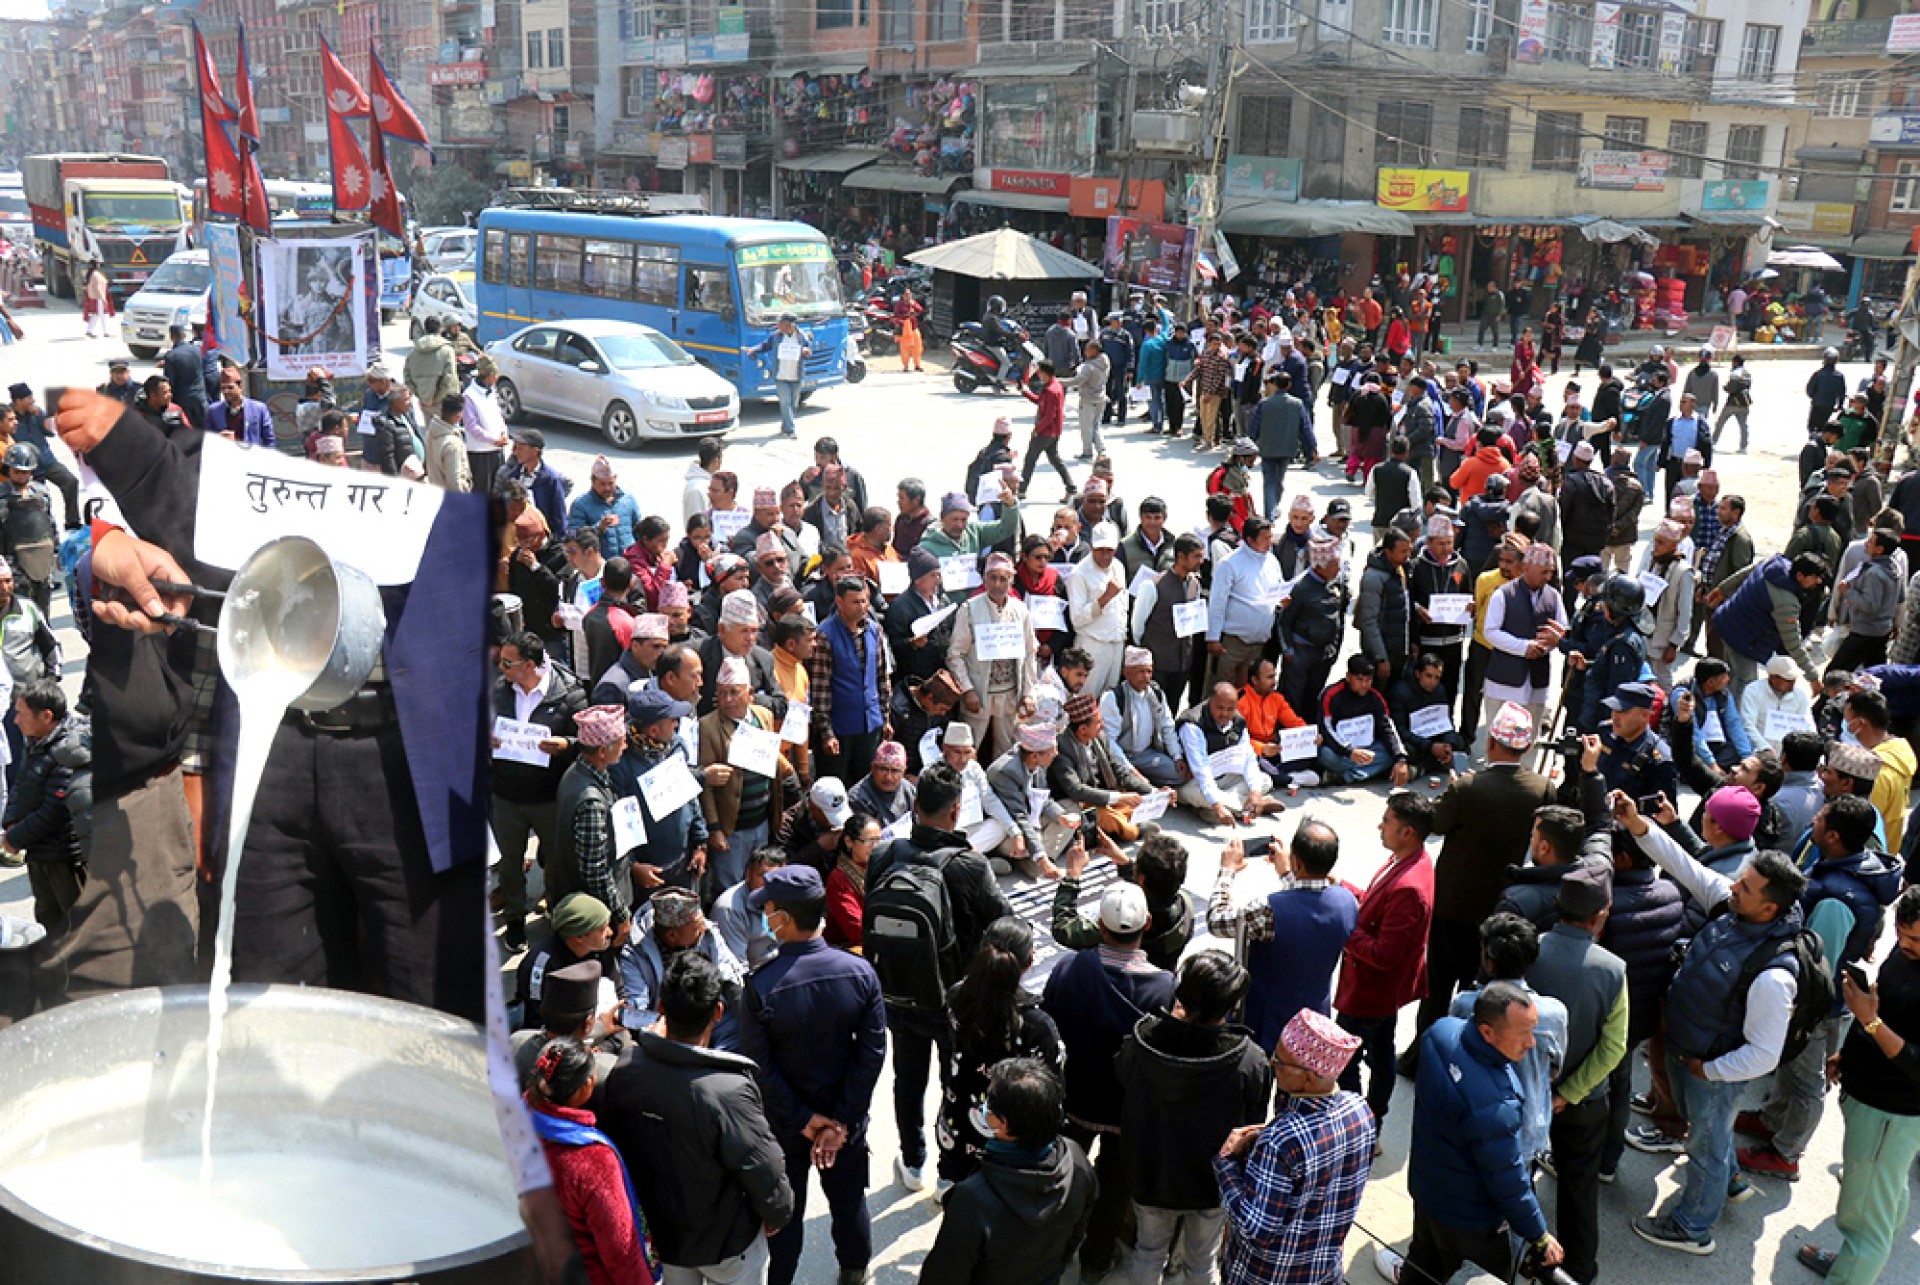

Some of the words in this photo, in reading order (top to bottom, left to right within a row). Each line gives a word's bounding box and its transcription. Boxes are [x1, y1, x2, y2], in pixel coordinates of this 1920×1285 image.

[246, 472, 332, 513] तुरुन्त
[347, 485, 389, 512] गर
[403, 487, 413, 515] !
